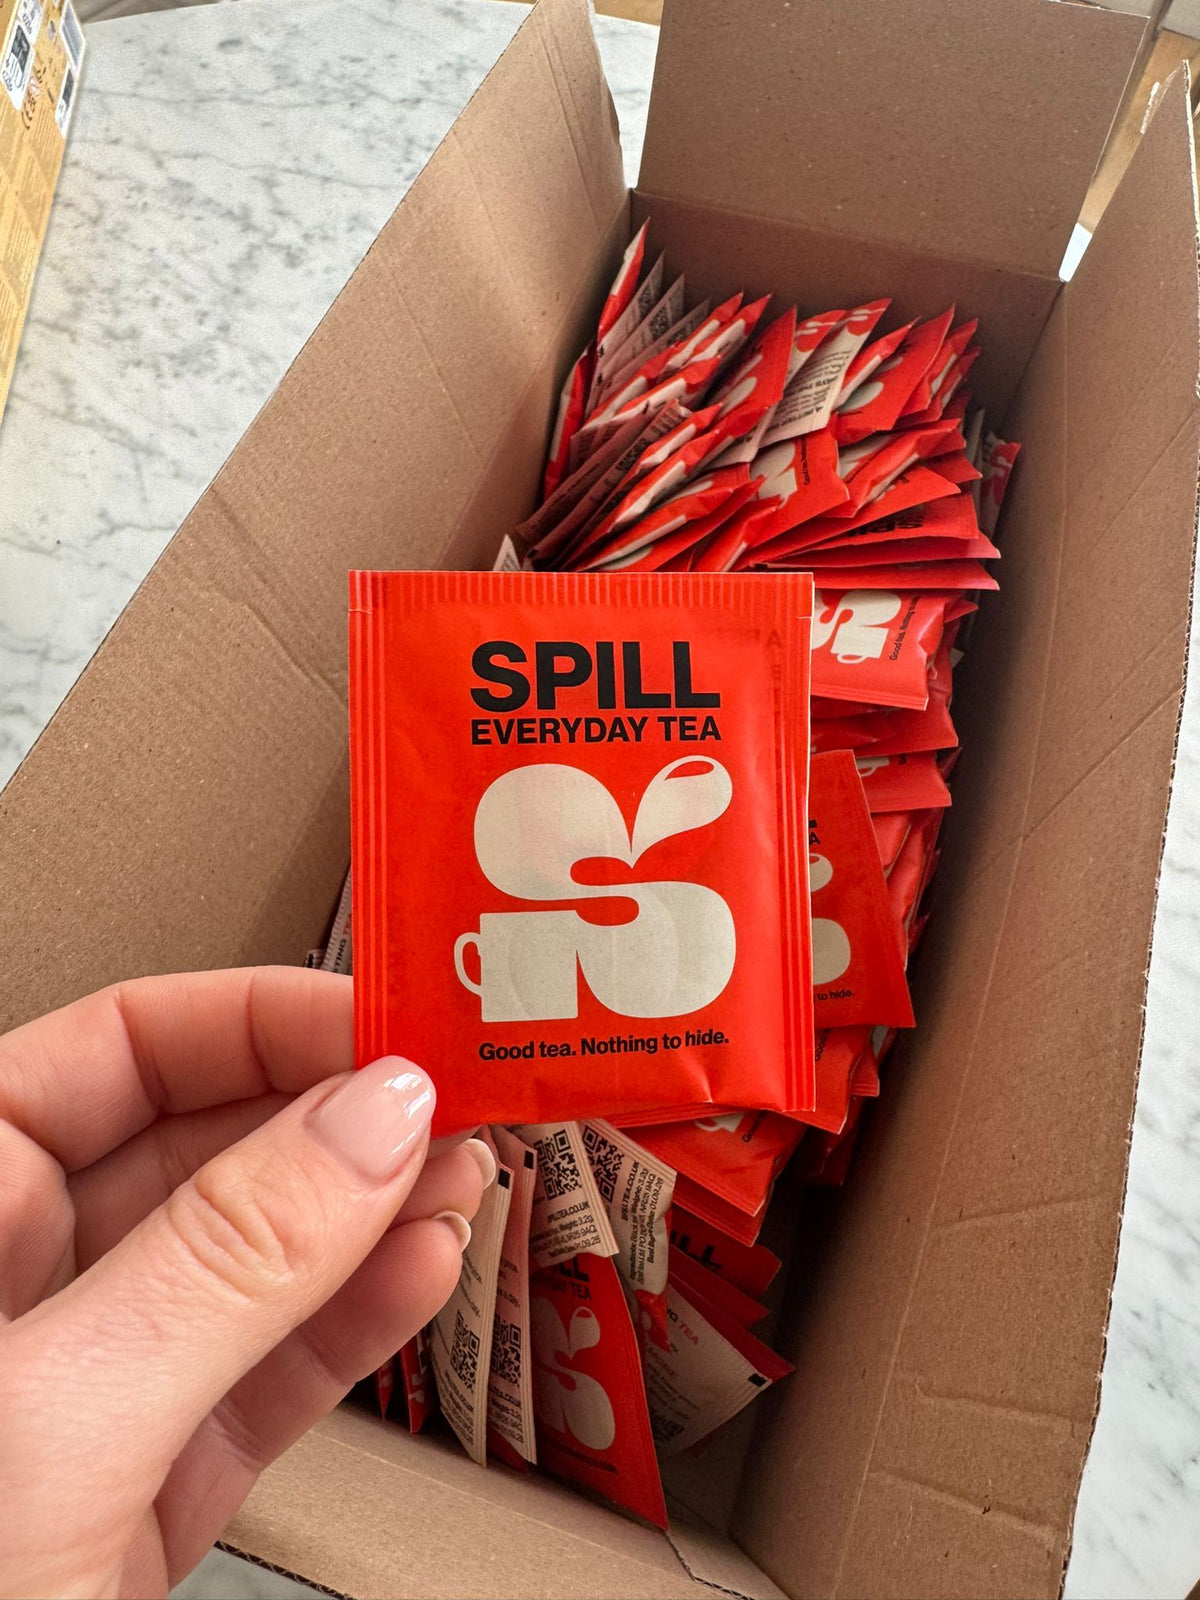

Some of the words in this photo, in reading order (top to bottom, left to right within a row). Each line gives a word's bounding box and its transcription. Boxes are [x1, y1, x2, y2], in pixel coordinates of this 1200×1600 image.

[470, 640, 721, 713] SPILL
[471, 716, 649, 745] EVERYDAY
[657, 715, 722, 741] TEA
[479, 1041, 535, 1060] Good
[539, 1042, 577, 1058] tea.
[580, 1035, 658, 1055] Nothing
[662, 1033, 682, 1049] to
[685, 1028, 729, 1047] hide.
